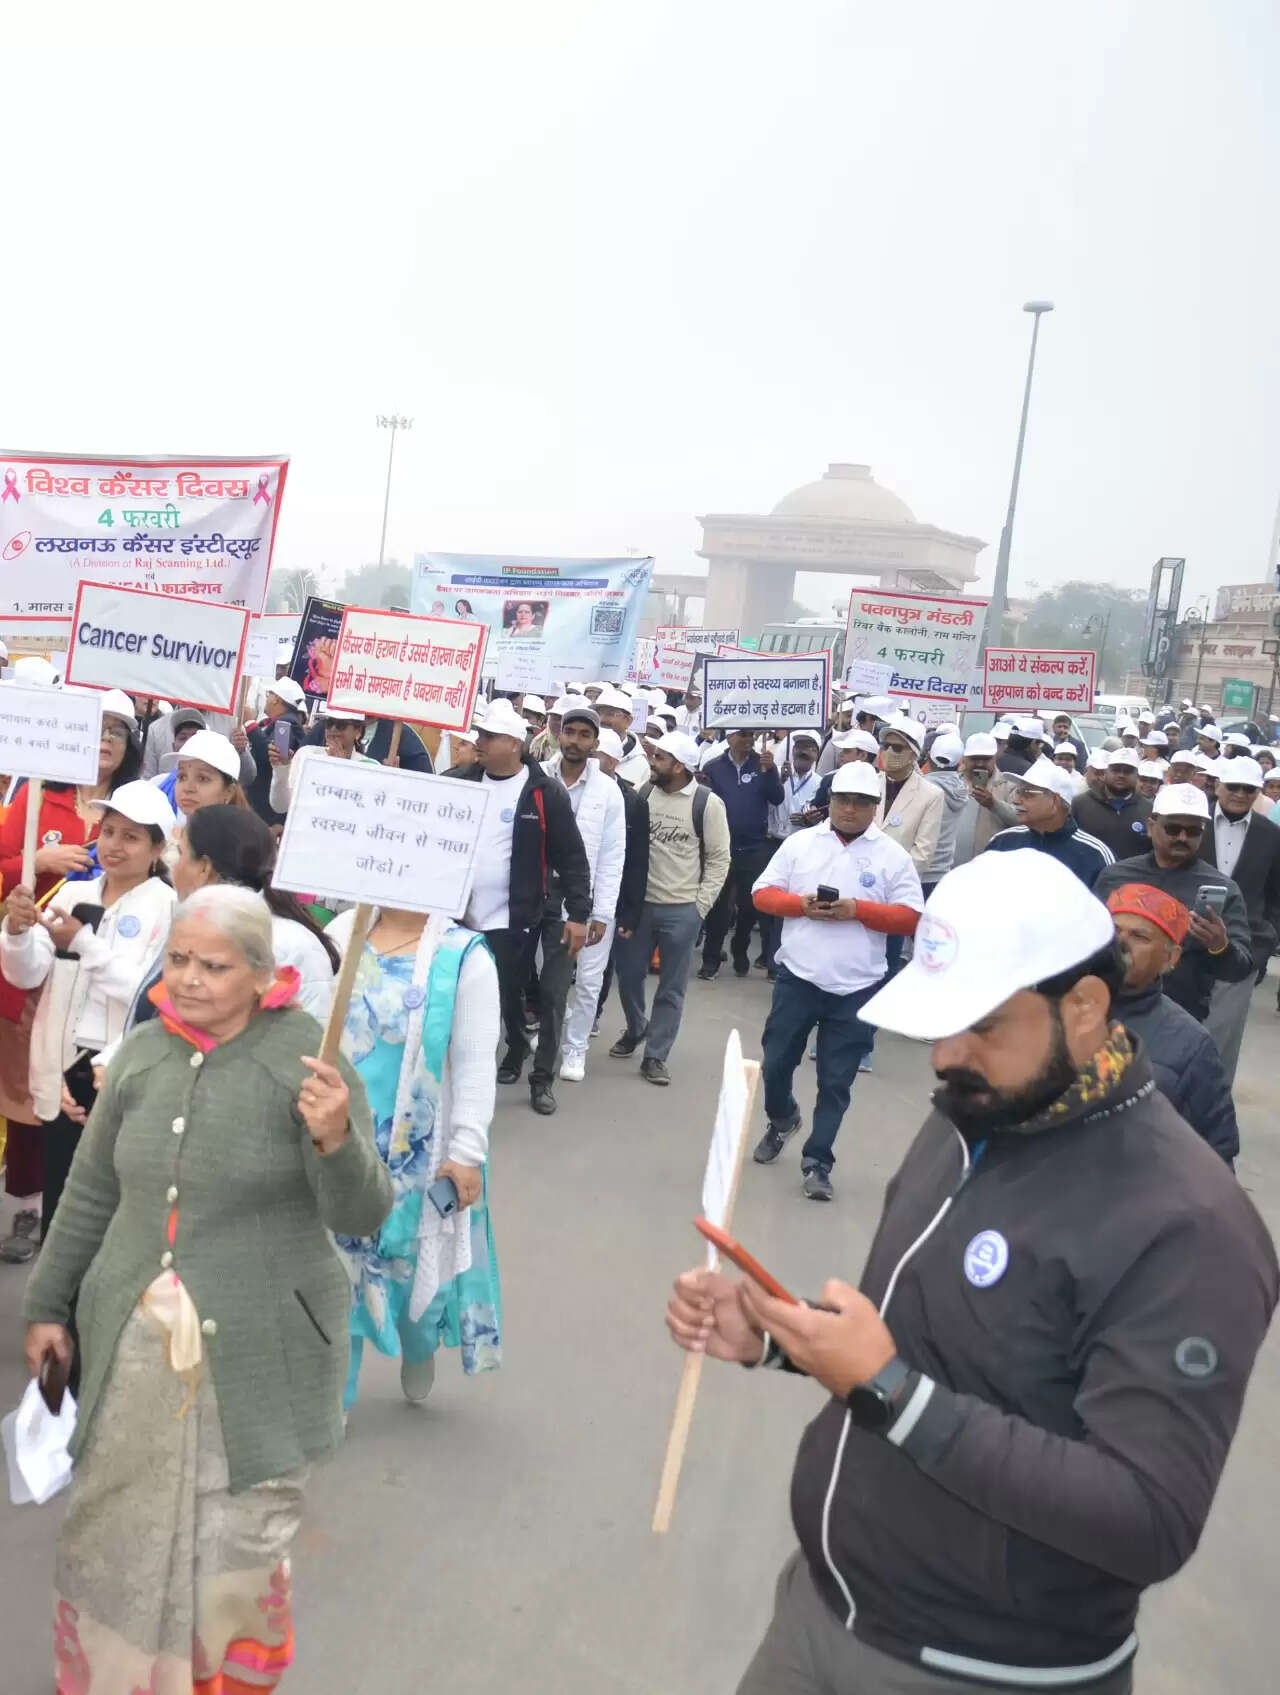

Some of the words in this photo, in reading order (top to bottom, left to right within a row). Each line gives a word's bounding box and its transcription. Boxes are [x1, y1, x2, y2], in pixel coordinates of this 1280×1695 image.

[26, 469, 91, 495] विश्व
[98, 471, 170, 497] कैंसर
[176, 472, 250, 497] दिवस
[98, 508, 114, 527] 4
[122, 503, 180, 528] फरवरी
[35, 536, 117, 553] लखनऊ
[122, 533, 174, 553] कैंसर
[135, 558, 152, 570] Raj
[156, 558, 202, 570] Scanning
[28, 602, 63, 612] मानस
[860, 603, 920, 624] पवनपुत्र
[926, 607, 974, 626] मंडली
[78, 622, 147, 655] Cancer
[152, 633, 236, 669] Survivor
[877, 647, 887, 658] 4
[894, 648, 945, 665] फरवरी
[989, 654, 1015, 673] आओ
[1018, 656, 1027, 672] ये
[1030, 656, 1064, 674] संकल्प
[708, 678, 737, 691] समाज
[738, 675, 751, 690] को
[782, 678, 810, 690] बनाना
[928, 676, 968, 695] दिवस
[1026, 682, 1040, 700] को
[739, 699, 751, 715] को
[771, 699, 781, 715] से
[373, 791, 385, 807] से
